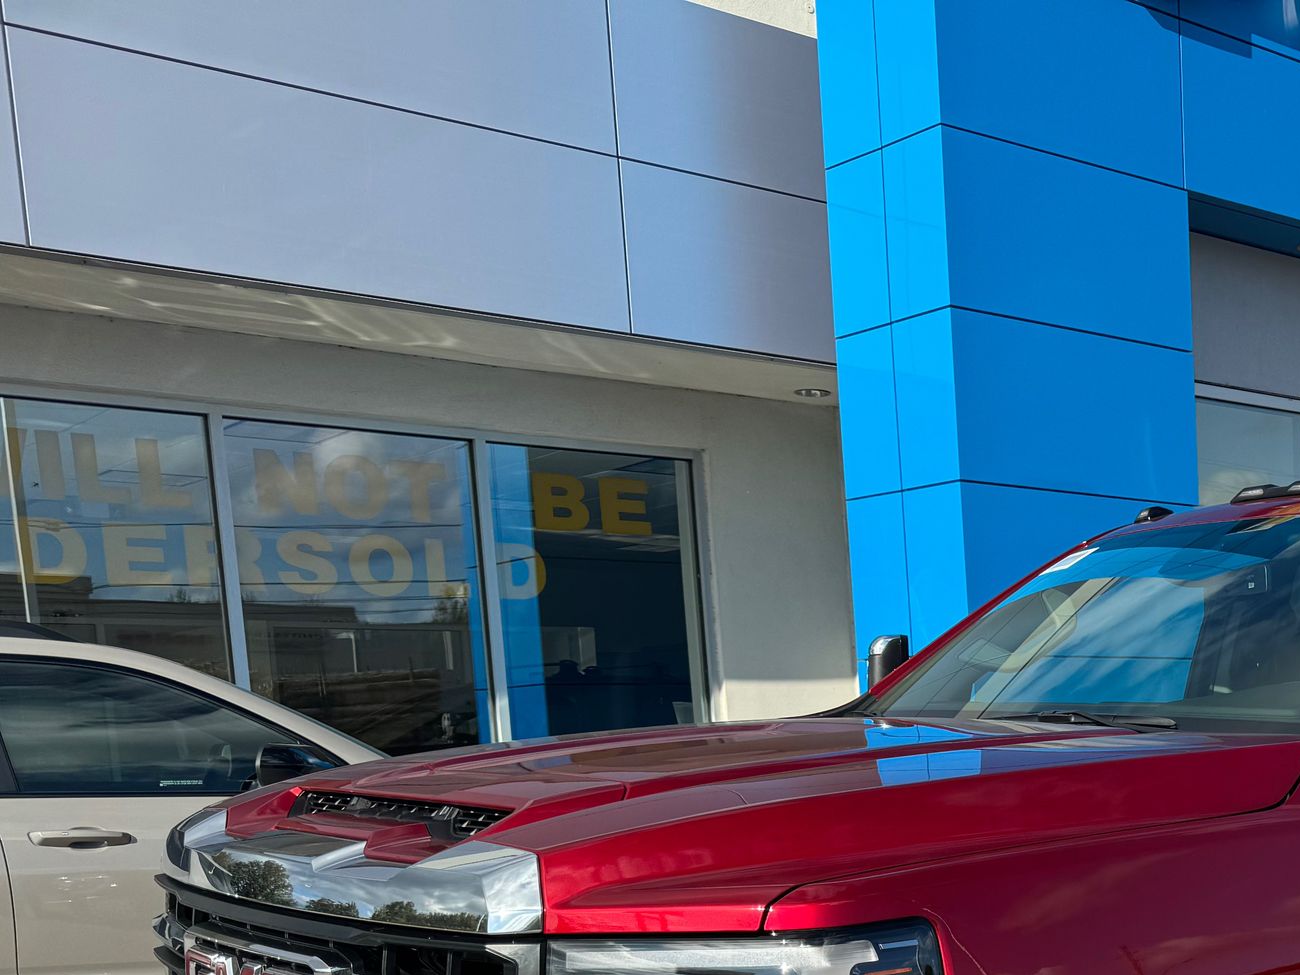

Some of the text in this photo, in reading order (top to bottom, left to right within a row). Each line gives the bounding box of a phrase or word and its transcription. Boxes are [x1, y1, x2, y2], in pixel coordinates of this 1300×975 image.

[0, 427, 652, 537] ILL NOT BE
